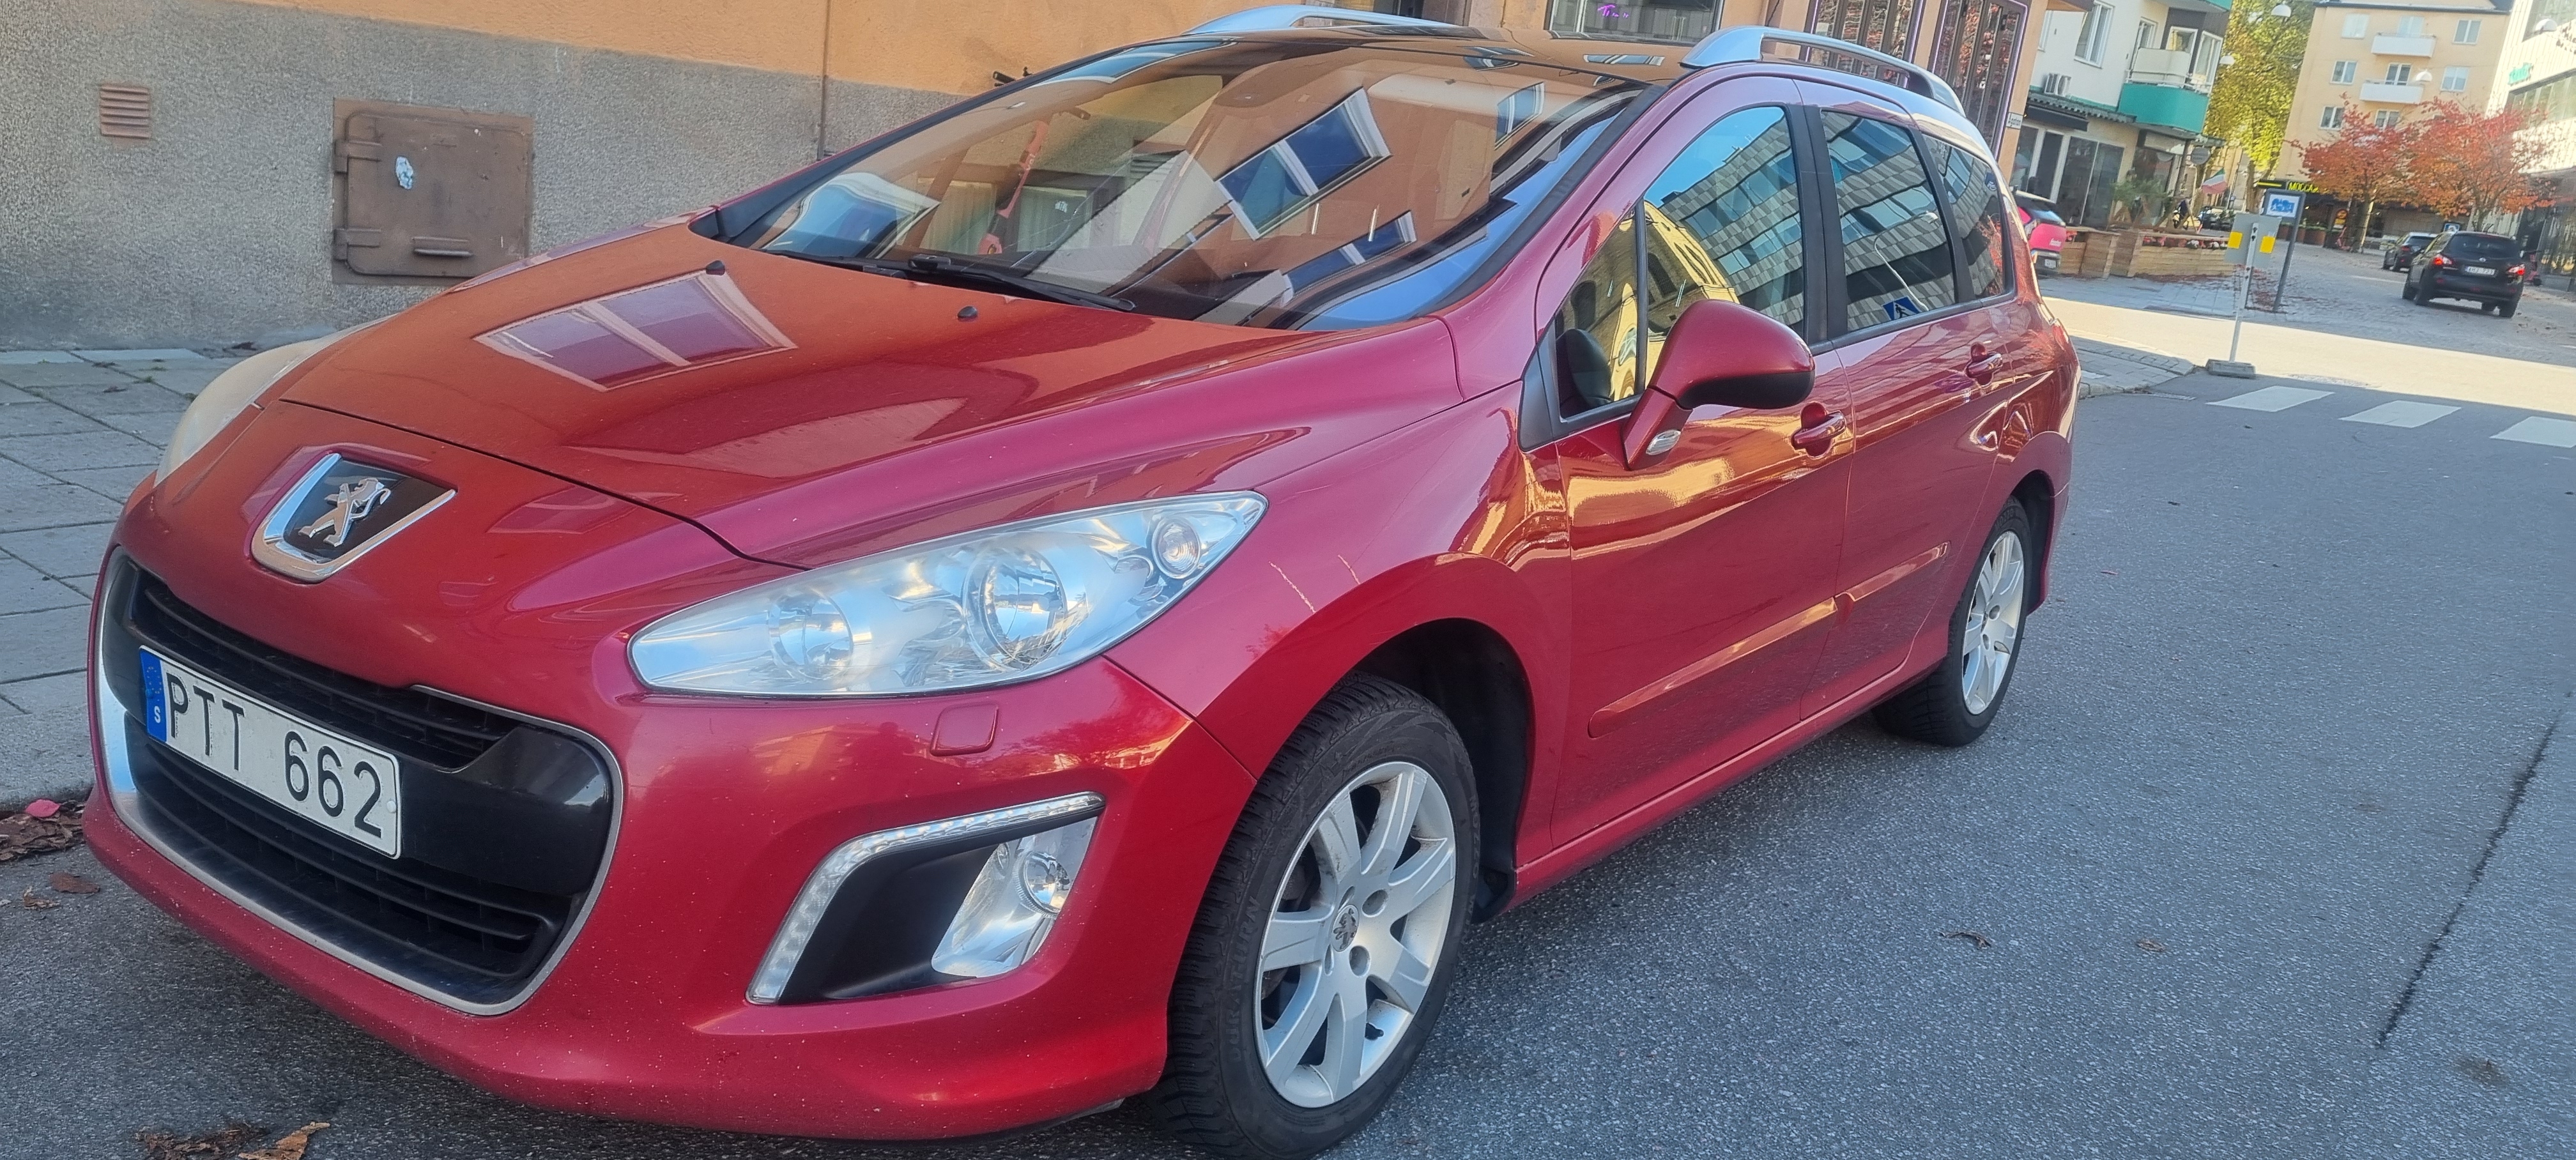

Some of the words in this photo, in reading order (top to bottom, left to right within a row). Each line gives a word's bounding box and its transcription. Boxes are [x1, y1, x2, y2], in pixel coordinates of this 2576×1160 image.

[154, 706, 161, 724] S
[166, 673, 244, 770] PTT
[284, 730, 383, 839] 662
